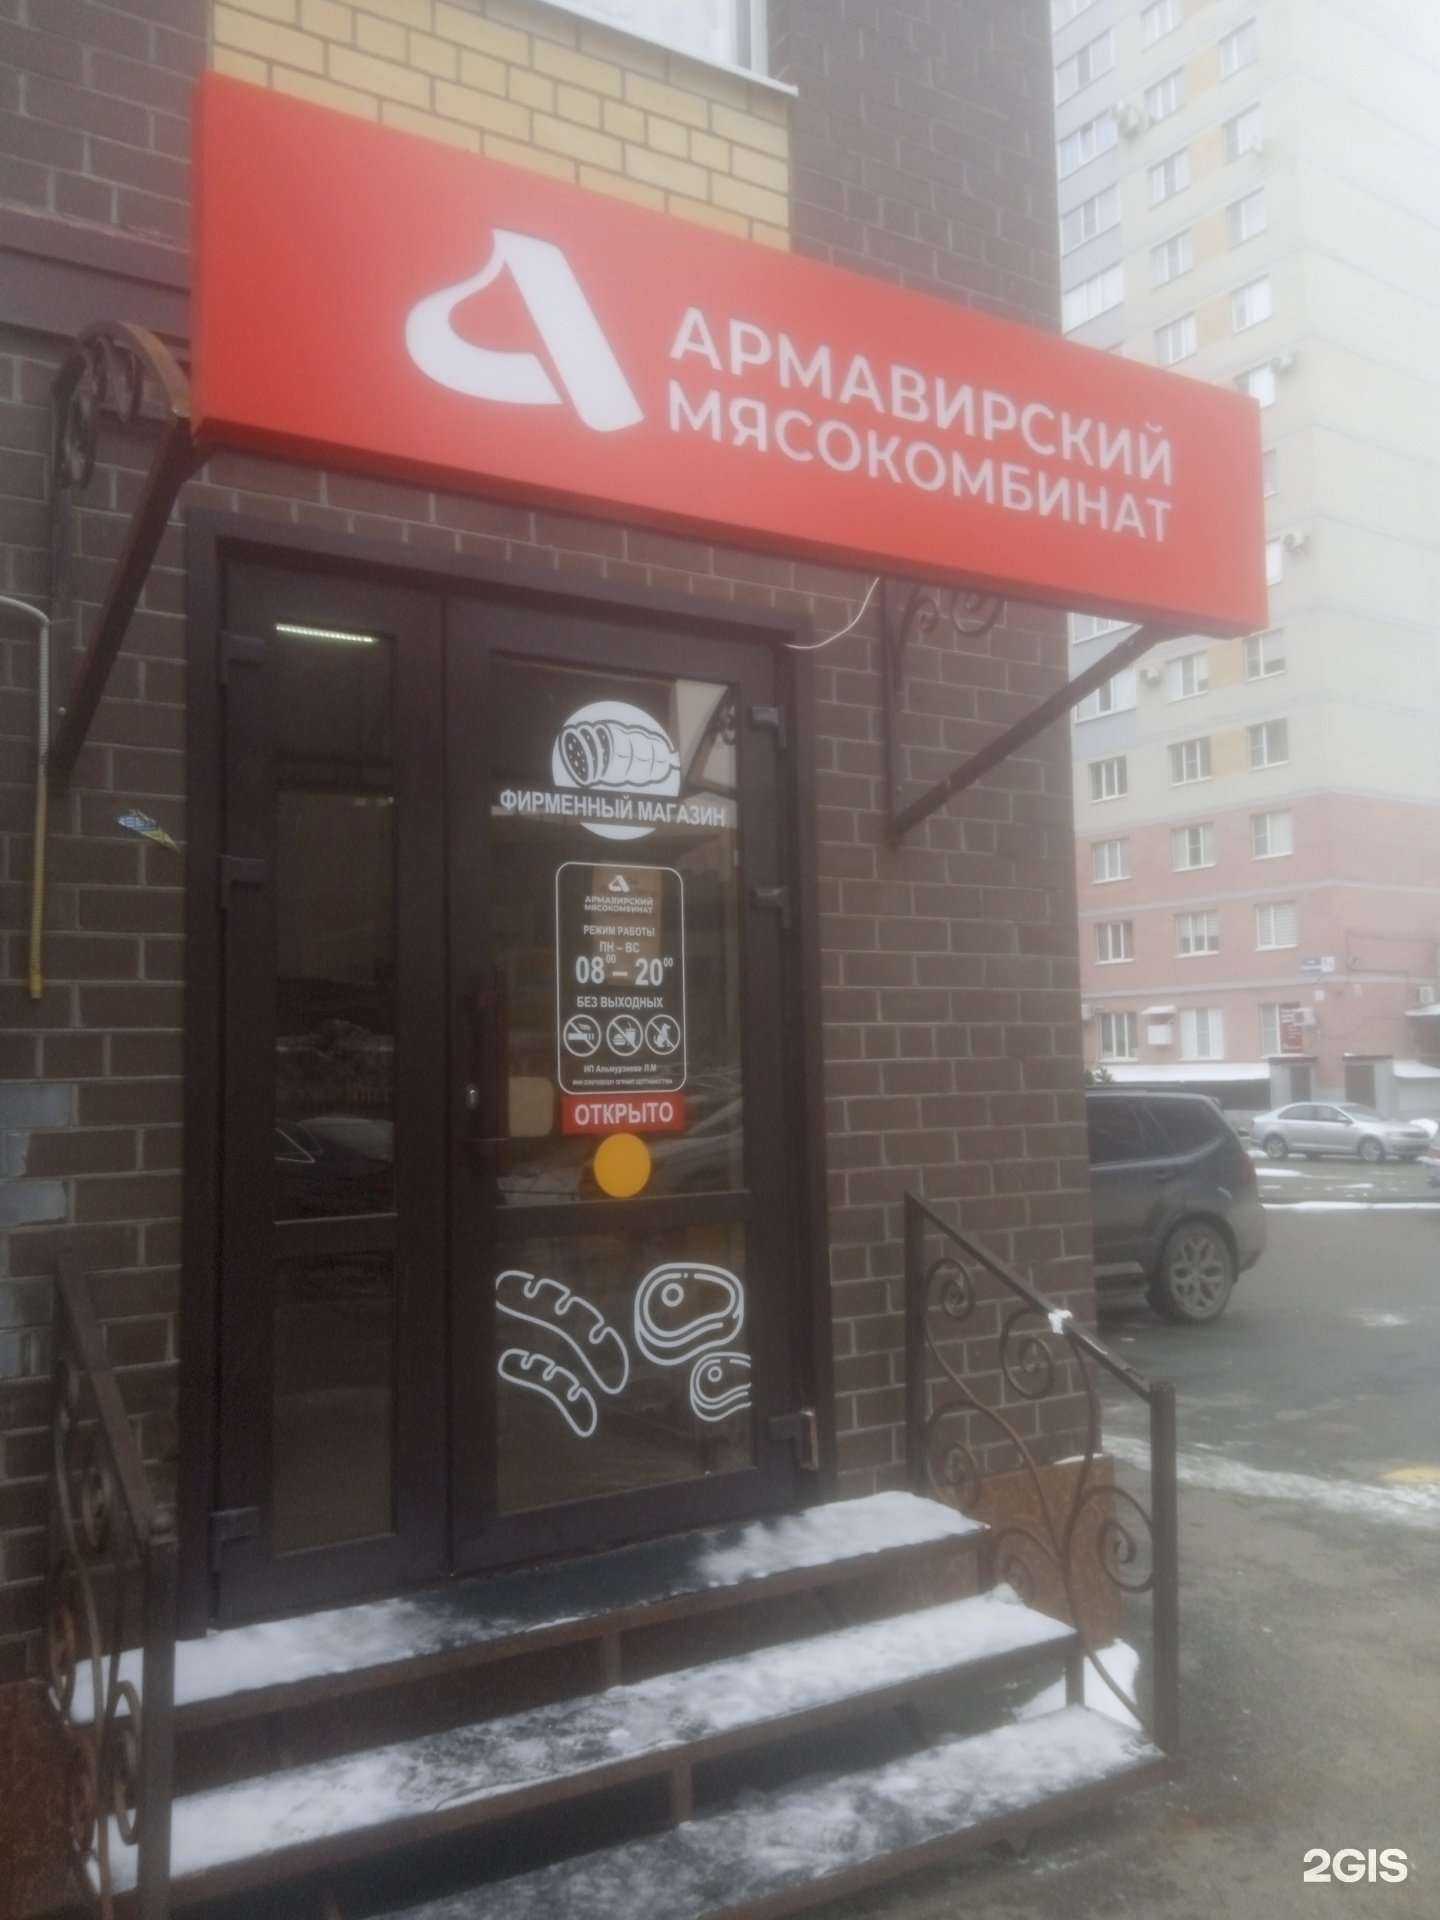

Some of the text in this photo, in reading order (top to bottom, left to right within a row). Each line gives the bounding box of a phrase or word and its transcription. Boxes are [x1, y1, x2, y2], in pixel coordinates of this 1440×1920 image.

[669, 306, 1174, 486] АРМАВИРСКИЙ
[668, 379, 1172, 542] МЯСОКОМБИНАТ
[500, 789, 725, 827] ФИРМЕННЫЙ МАГАЗИН
[583, 925, 656, 937] РЕЖИМ РАБОТЫ
[599, 940, 614, 953] ПН
[625, 942, 641, 953] ВС
[576, 996, 664, 1010] БЕЗ ВЫХОДНЫХ
[574, 1102, 674, 1125] ОТКРЫТО
